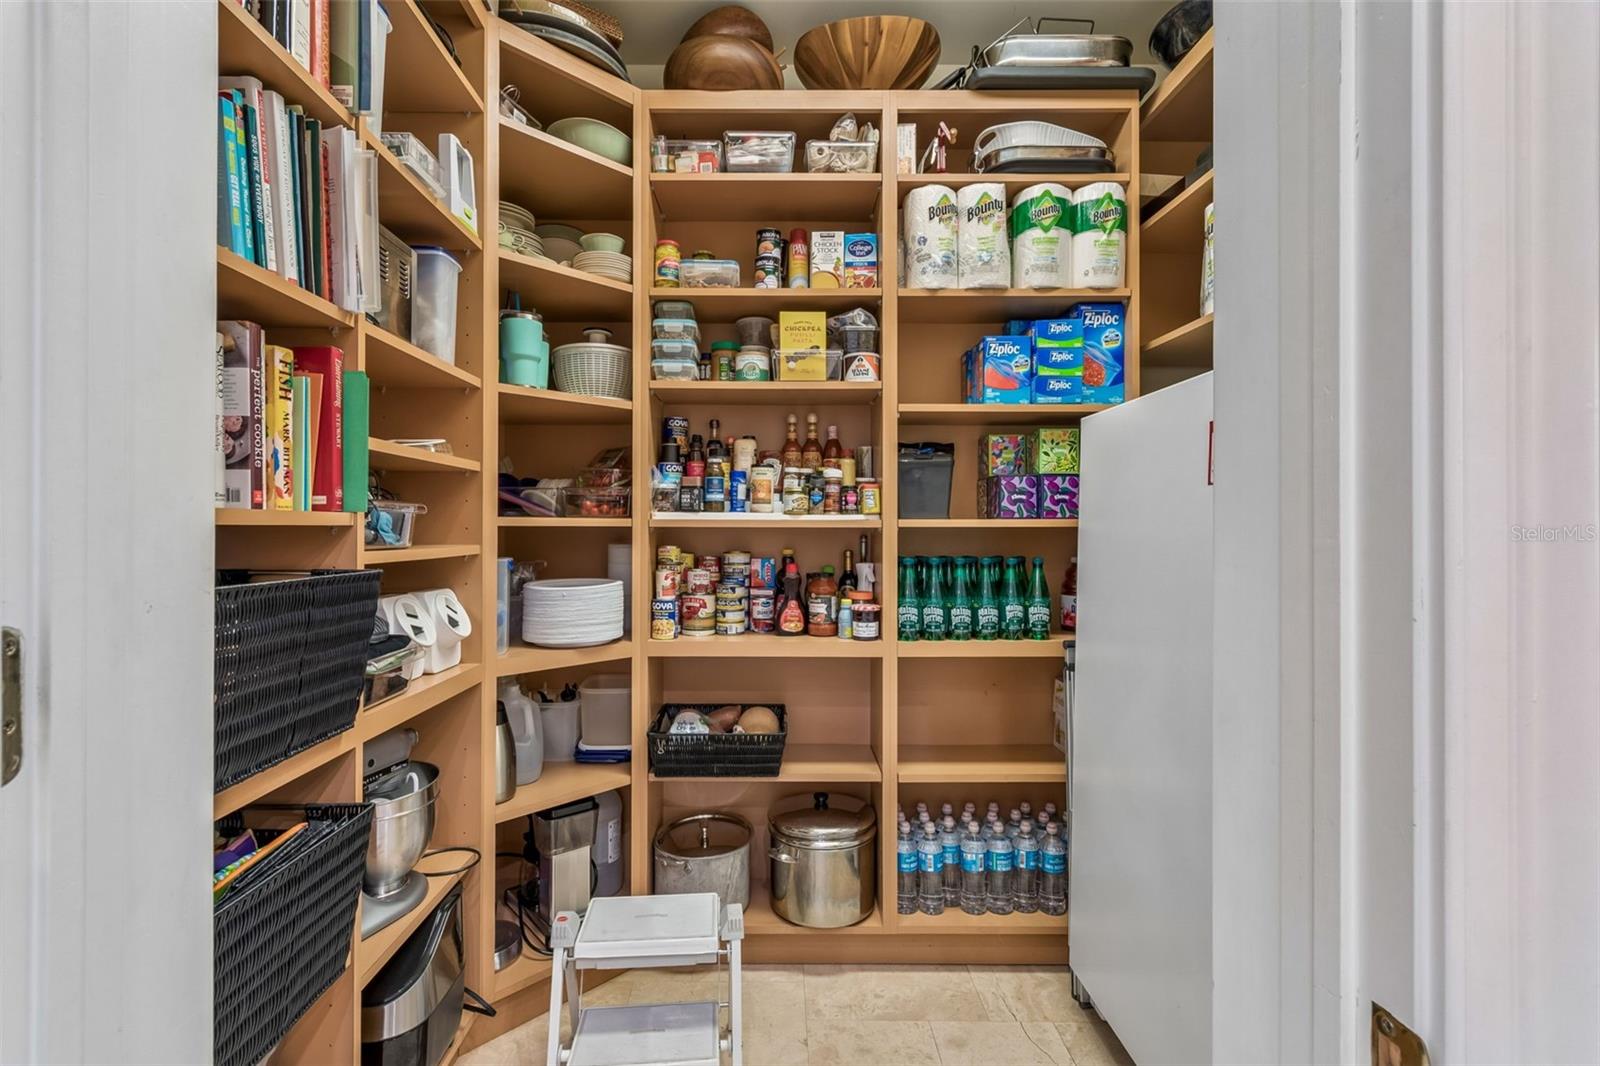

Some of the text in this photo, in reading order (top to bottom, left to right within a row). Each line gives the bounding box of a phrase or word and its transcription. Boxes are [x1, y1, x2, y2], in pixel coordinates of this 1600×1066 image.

[255, 183, 264, 224] EVERYBODY
[967, 198, 1003, 223] Bounty
[1031, 204, 1061, 221] Bounty
[1093, 206, 1121, 223] Bounty
[848, 243, 872, 252] College
[1050, 323, 1072, 333] Ziploc
[1084, 311, 1119, 328] Ziploc
[989, 343, 1020, 357] Ziploc
[1051, 352, 1074, 362] Ziploc
[333, 358, 342, 408] Entertaining
[1048, 380, 1072, 391] Ziploc
[251, 368, 262, 468] perfect cookie
[279, 359, 293, 494] FISH MARK BITTMAN
[652, 602, 673, 610] GOYA
